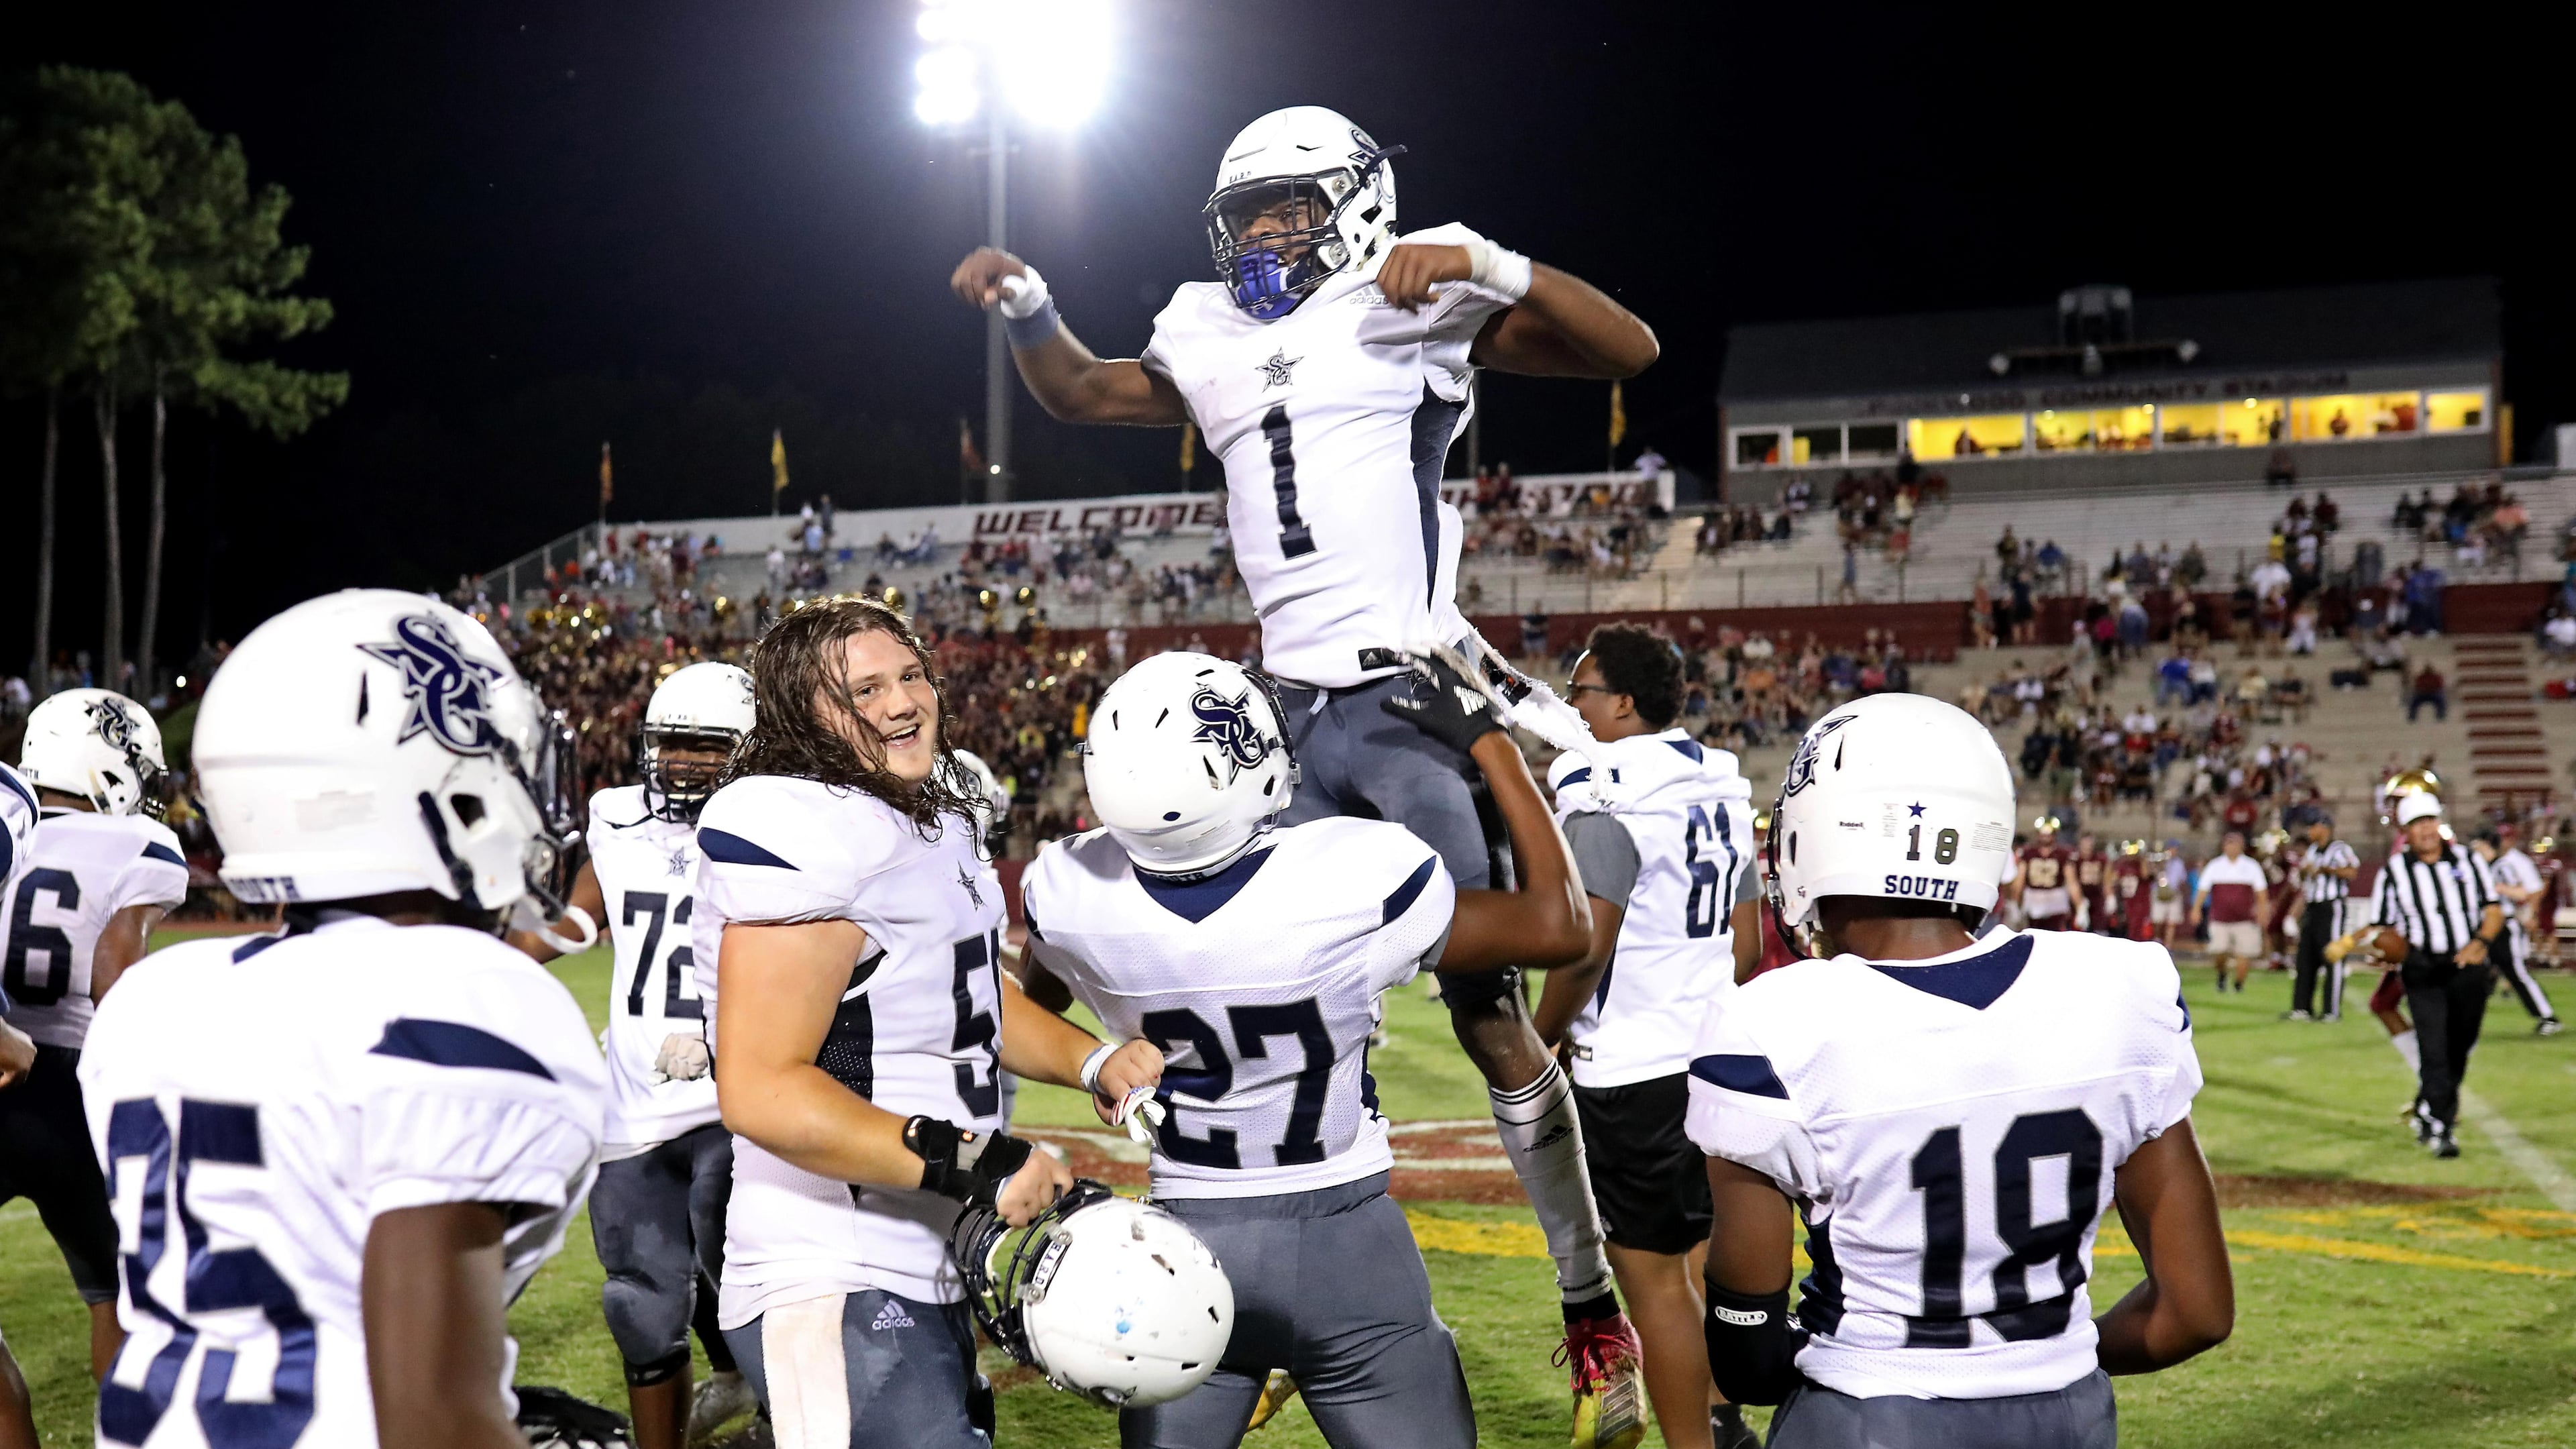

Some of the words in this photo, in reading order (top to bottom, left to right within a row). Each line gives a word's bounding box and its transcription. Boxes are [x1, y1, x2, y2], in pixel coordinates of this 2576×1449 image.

[2041, 382, 2208, 407] COMMUNITY
[973, 502, 1222, 535] WELCOME
[1260, 404, 1318, 561] 1
[1685, 802, 1738, 938] 61
[1884, 874, 1960, 900] SOUTH
[1907, 824, 1960, 865] 18
[3, 867, 81, 1006] 6
[623, 890, 704, 1020] 72
[951, 926, 1002, 1121] 5
[1142, 994, 1336, 1169] 27
[1911, 1107, 2104, 1349] 18
[871, 1316, 915, 1331] adidas
[1717, 1308, 1766, 1325] BATTLE
